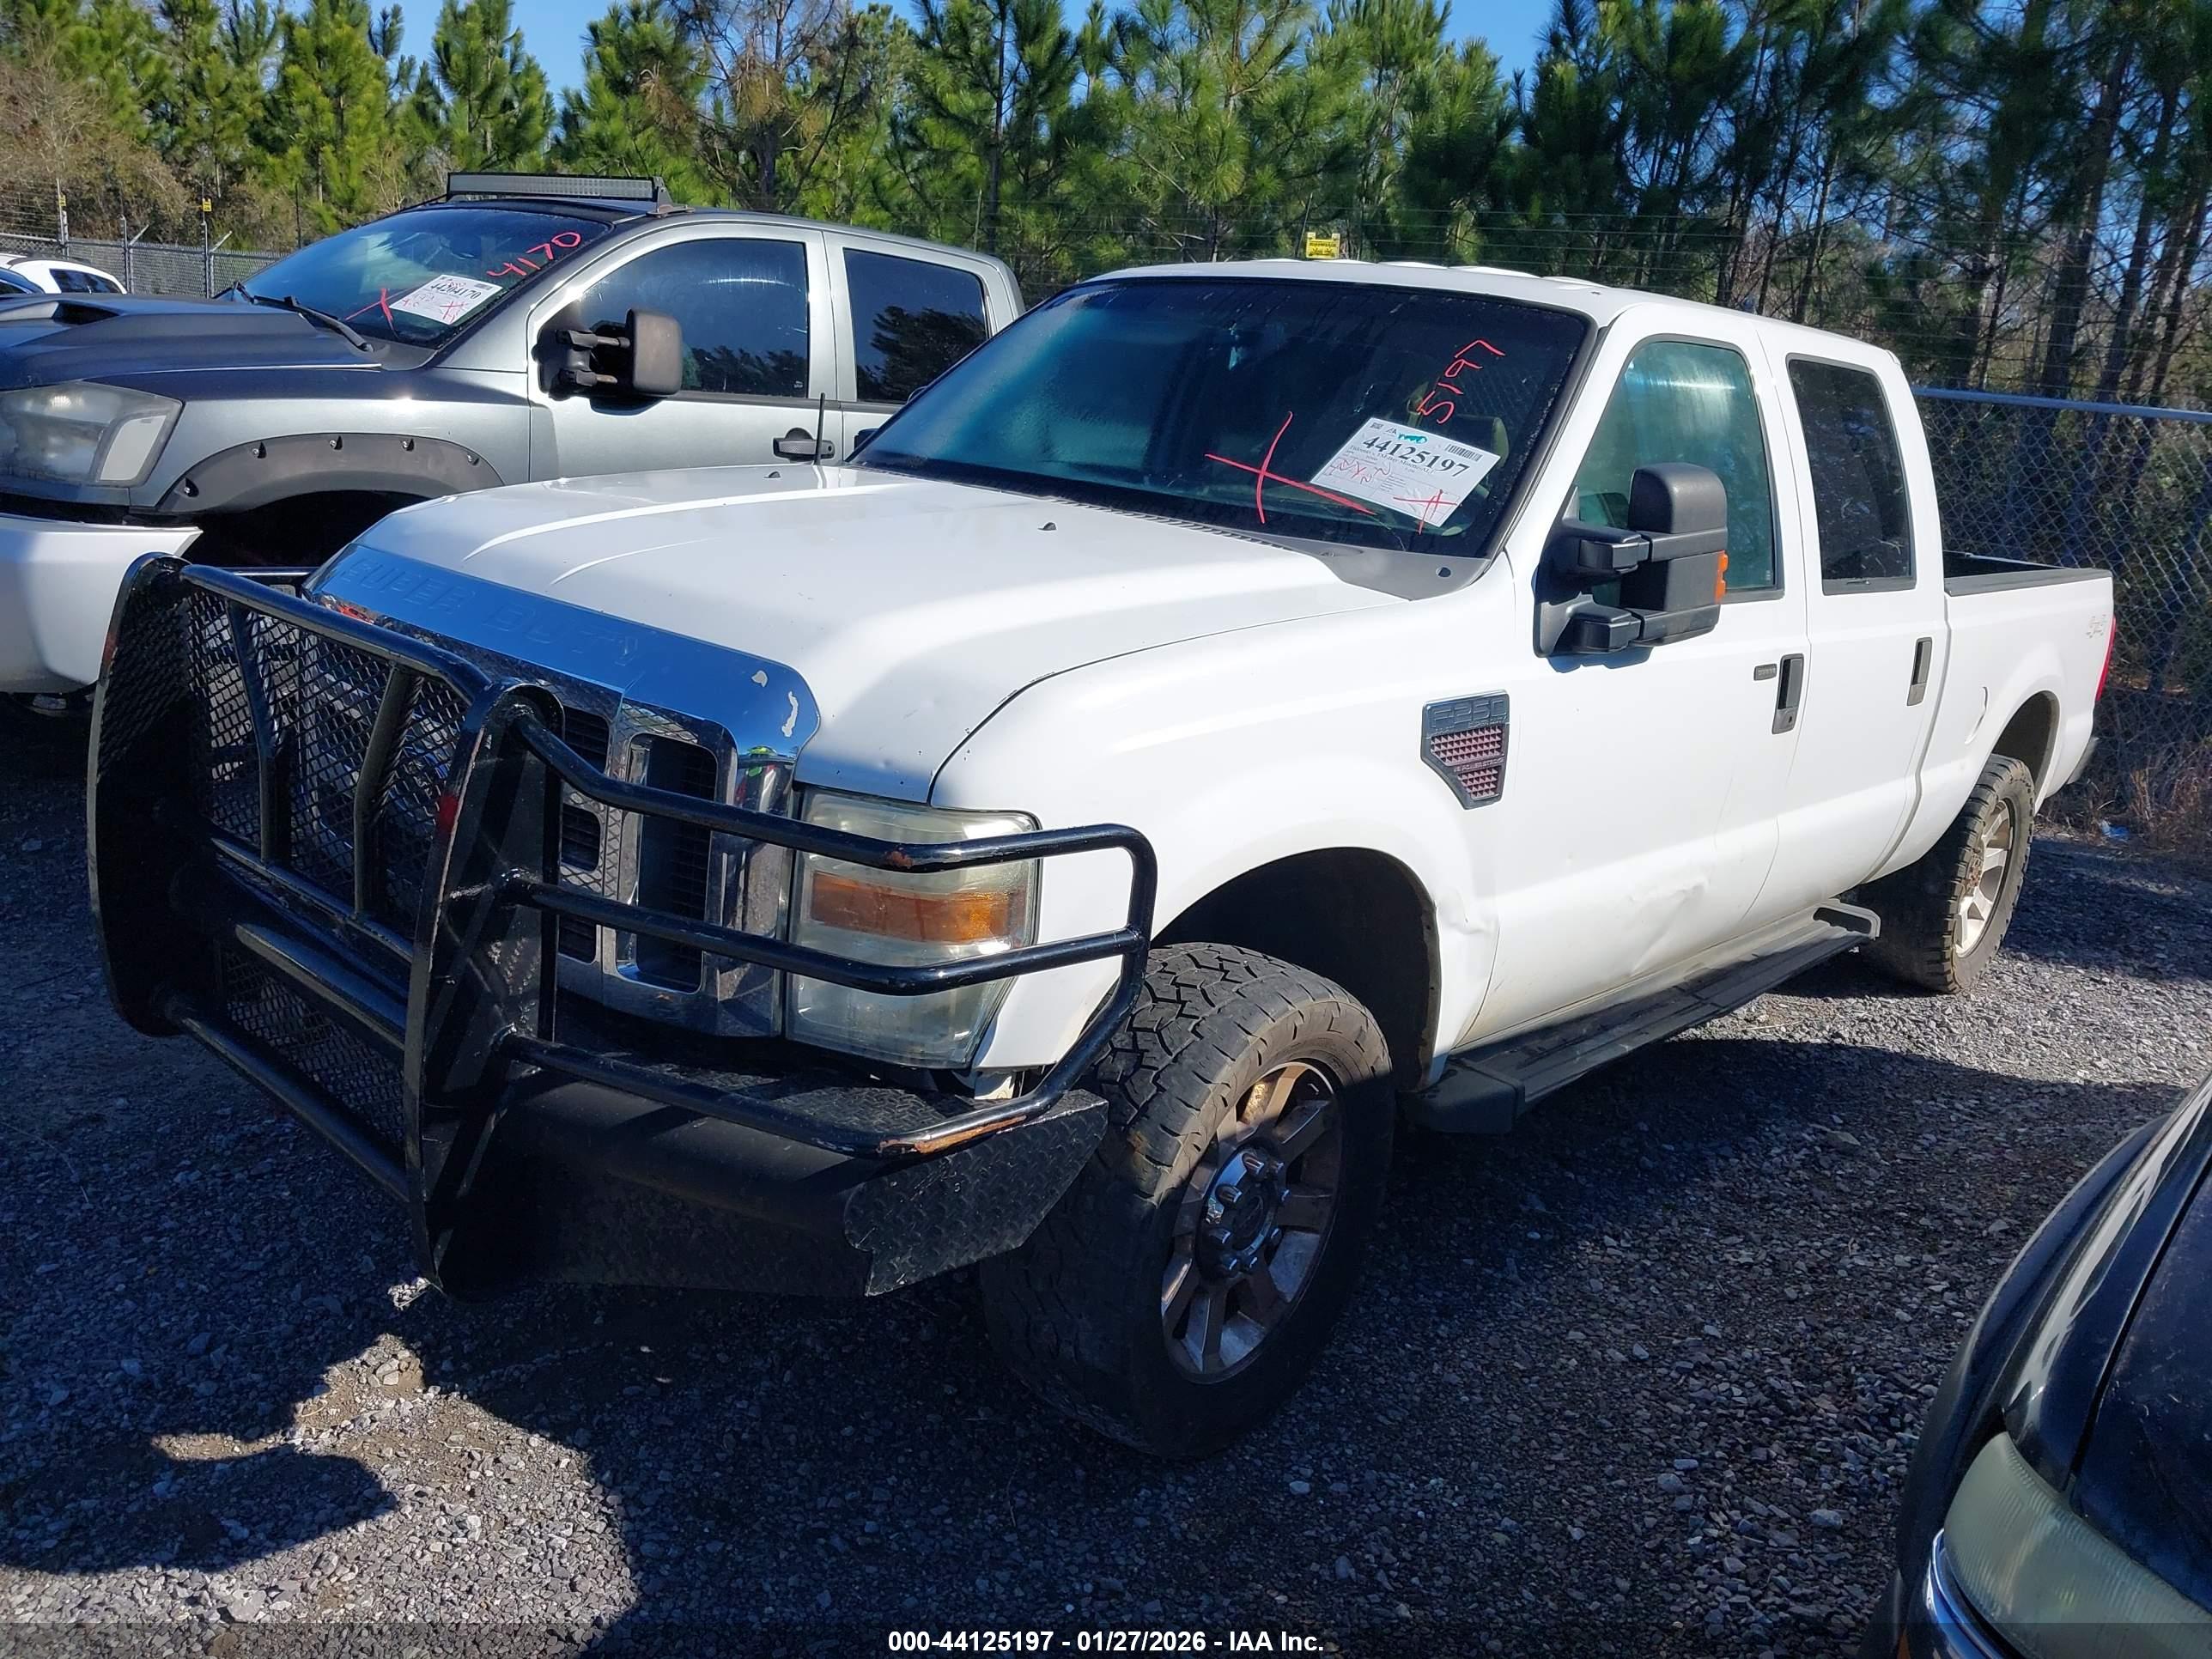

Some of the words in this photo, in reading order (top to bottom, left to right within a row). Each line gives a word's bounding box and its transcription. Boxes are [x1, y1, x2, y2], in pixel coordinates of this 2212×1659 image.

[486, 231, 582, 276] 4170
[1416, 339, 1506, 424] 5197
[1362, 435, 1471, 477] 44125197
